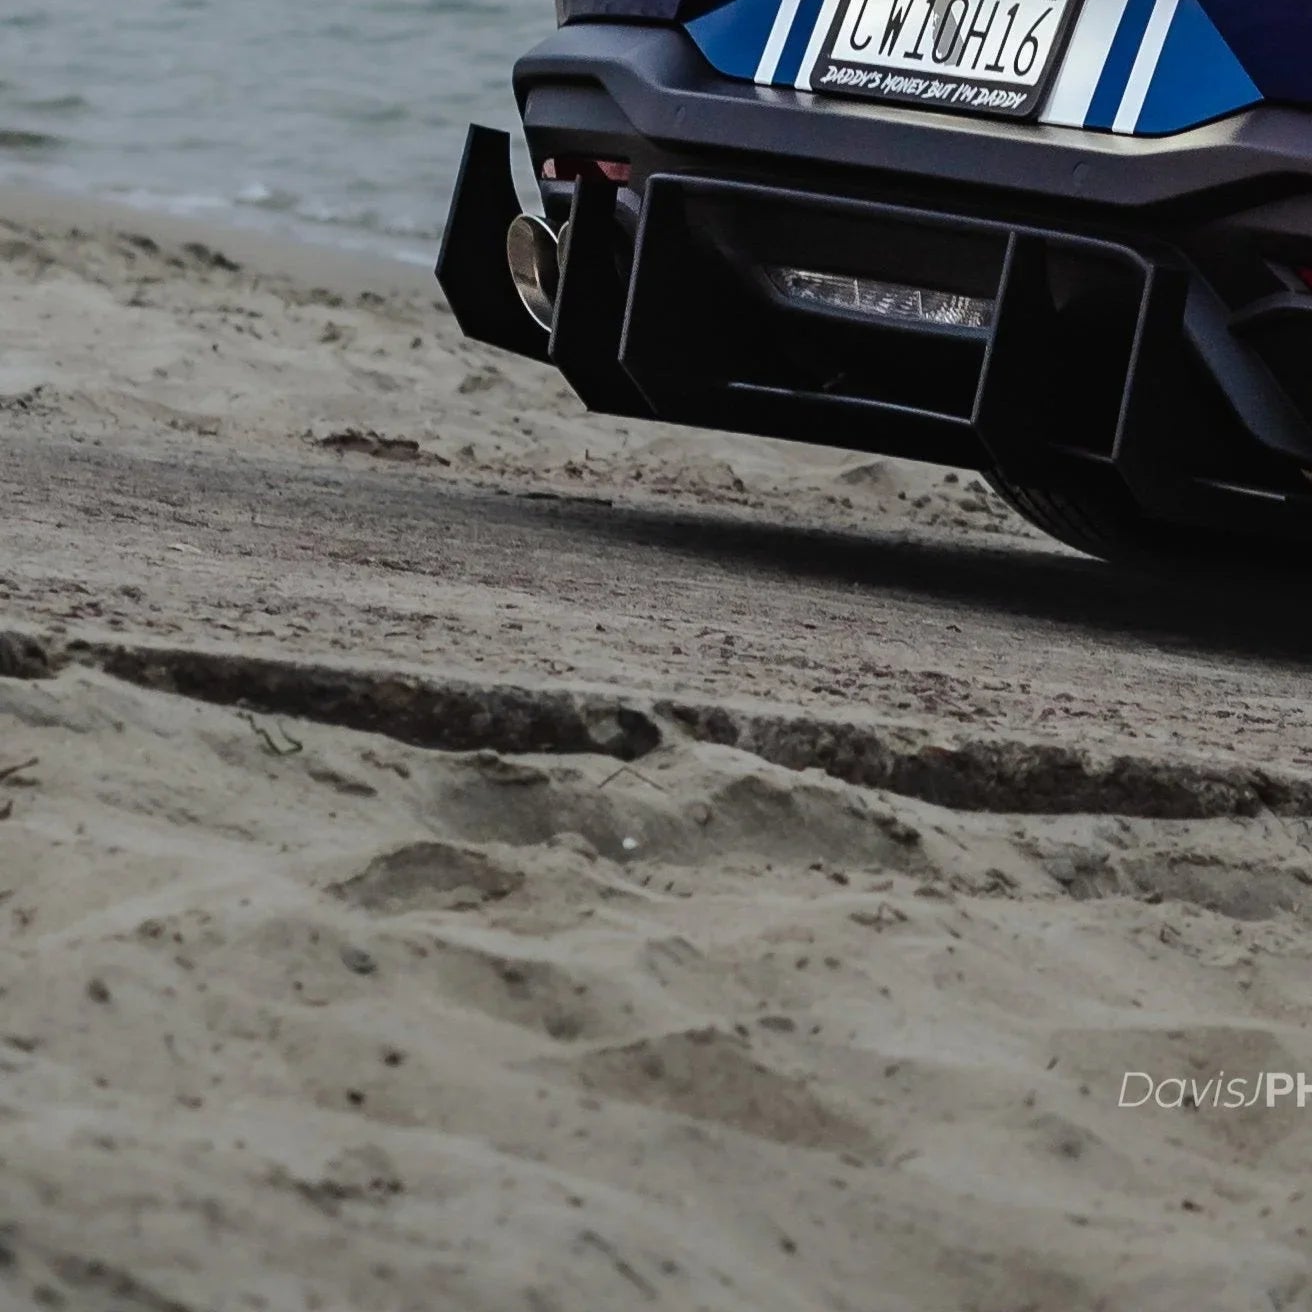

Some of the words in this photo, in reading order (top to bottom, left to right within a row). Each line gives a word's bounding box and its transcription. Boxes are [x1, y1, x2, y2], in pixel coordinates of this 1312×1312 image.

[820, 66, 883, 89] DADDY'S
[881, 74, 928, 95] MONEY
[922, 80, 957, 101] BUT
[951, 83, 977, 103] I'M
[972, 88, 1027, 109] DADDY
